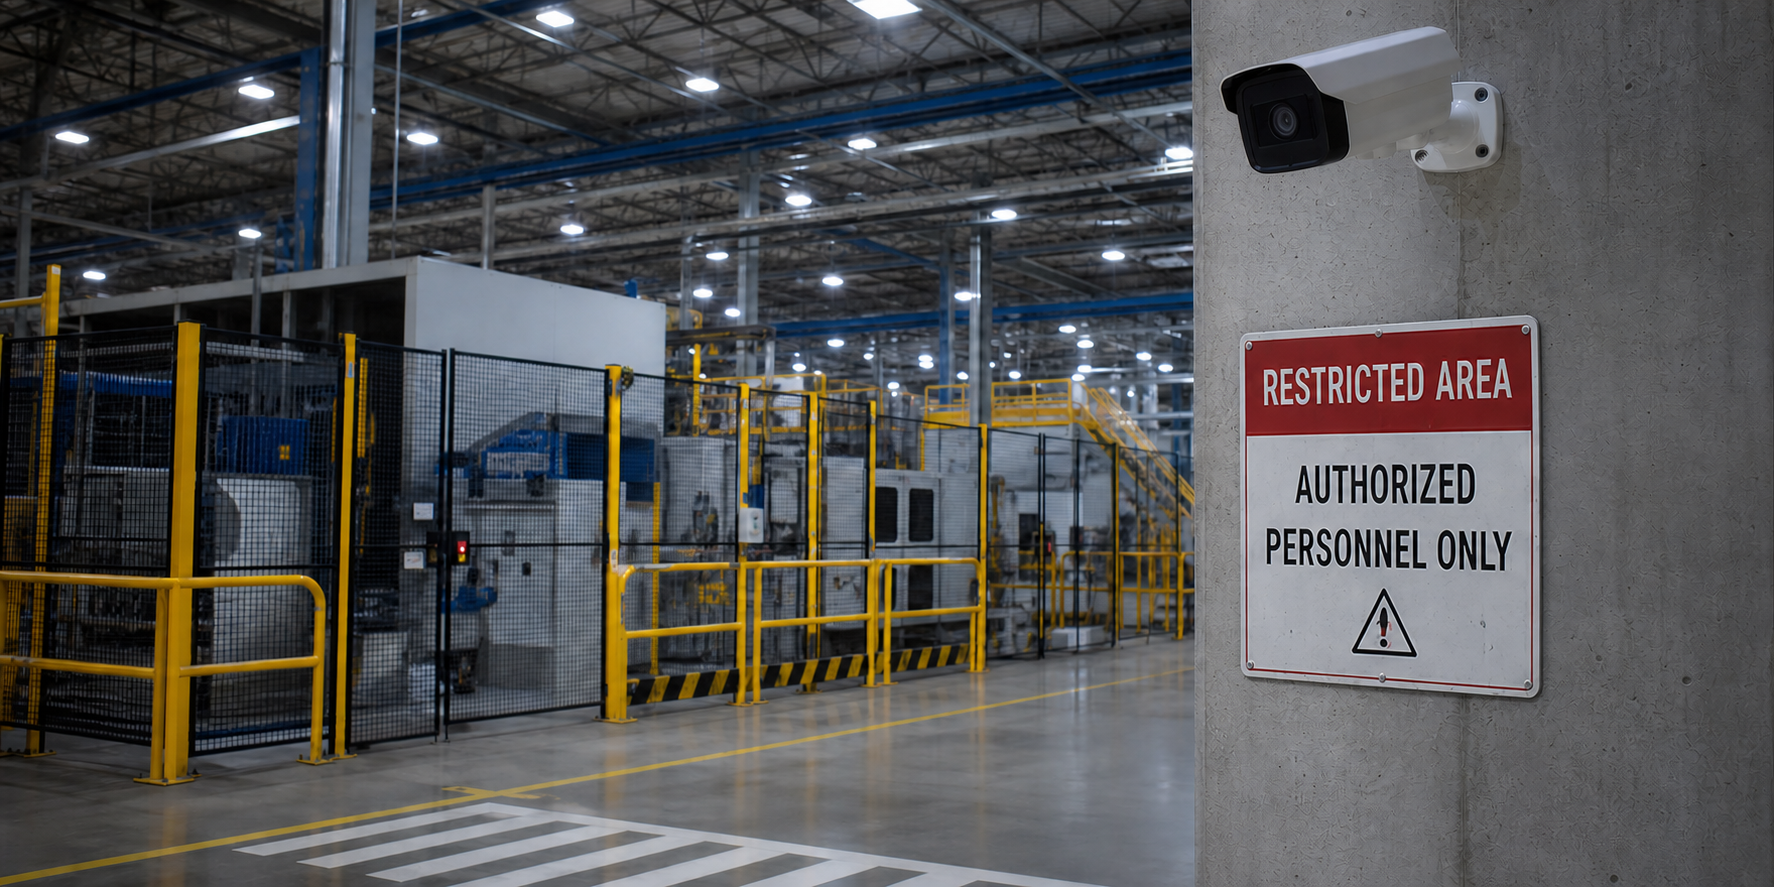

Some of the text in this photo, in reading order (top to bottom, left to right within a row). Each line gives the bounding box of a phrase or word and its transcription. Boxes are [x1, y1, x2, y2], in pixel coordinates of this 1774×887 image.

[1263, 358, 1512, 405] RESTRICTED AREA
[1295, 463, 1476, 504] AUTHORIZED
[1266, 528, 1512, 571] PERSONNEL ONLY
